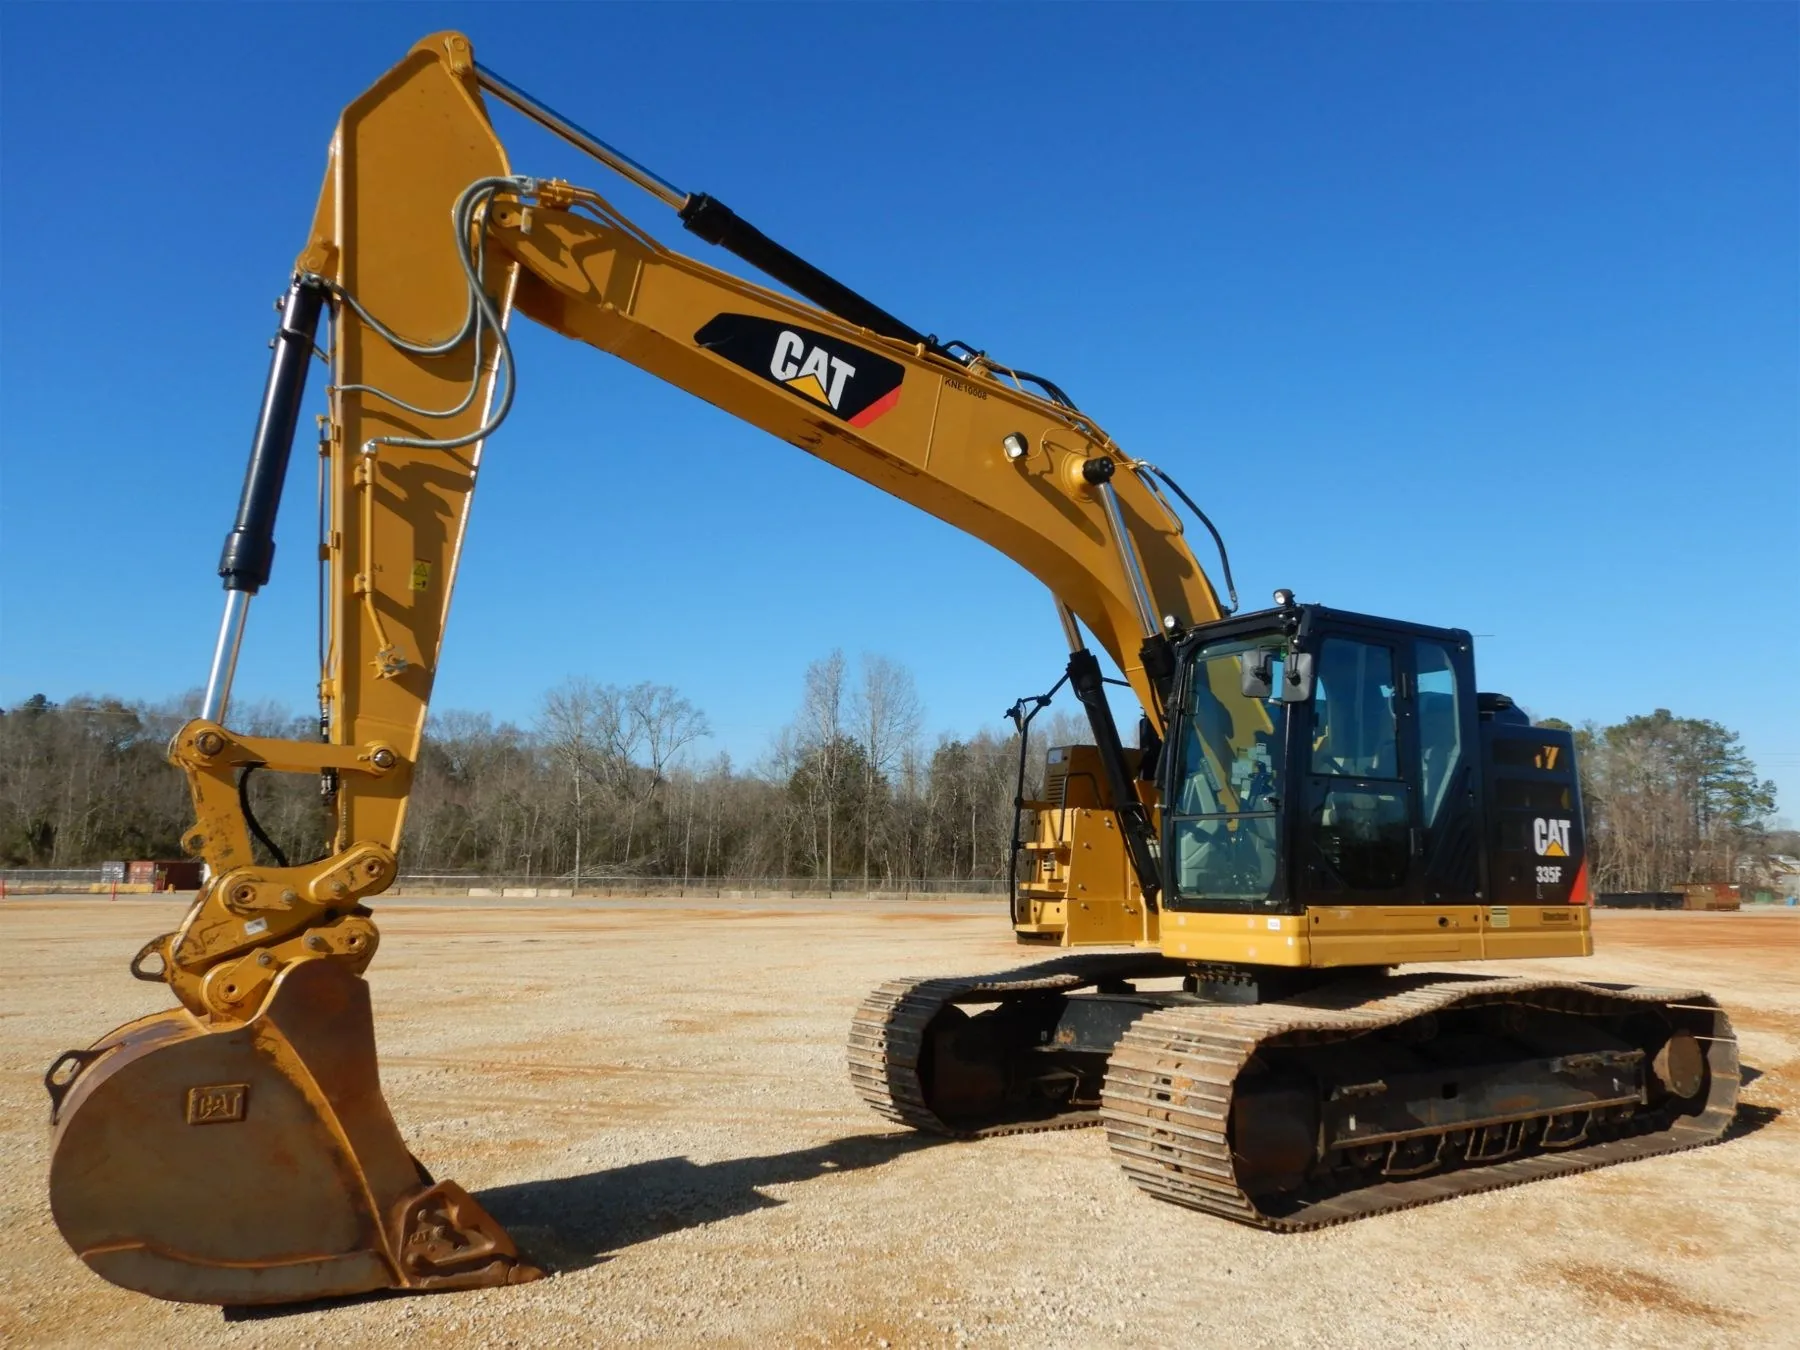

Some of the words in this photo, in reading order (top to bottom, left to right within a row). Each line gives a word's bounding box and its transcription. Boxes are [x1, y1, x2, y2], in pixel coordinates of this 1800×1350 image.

[770, 330, 856, 411] CAT
[1534, 817, 1571, 857] CAT
[1535, 865, 1562, 883] 335F
